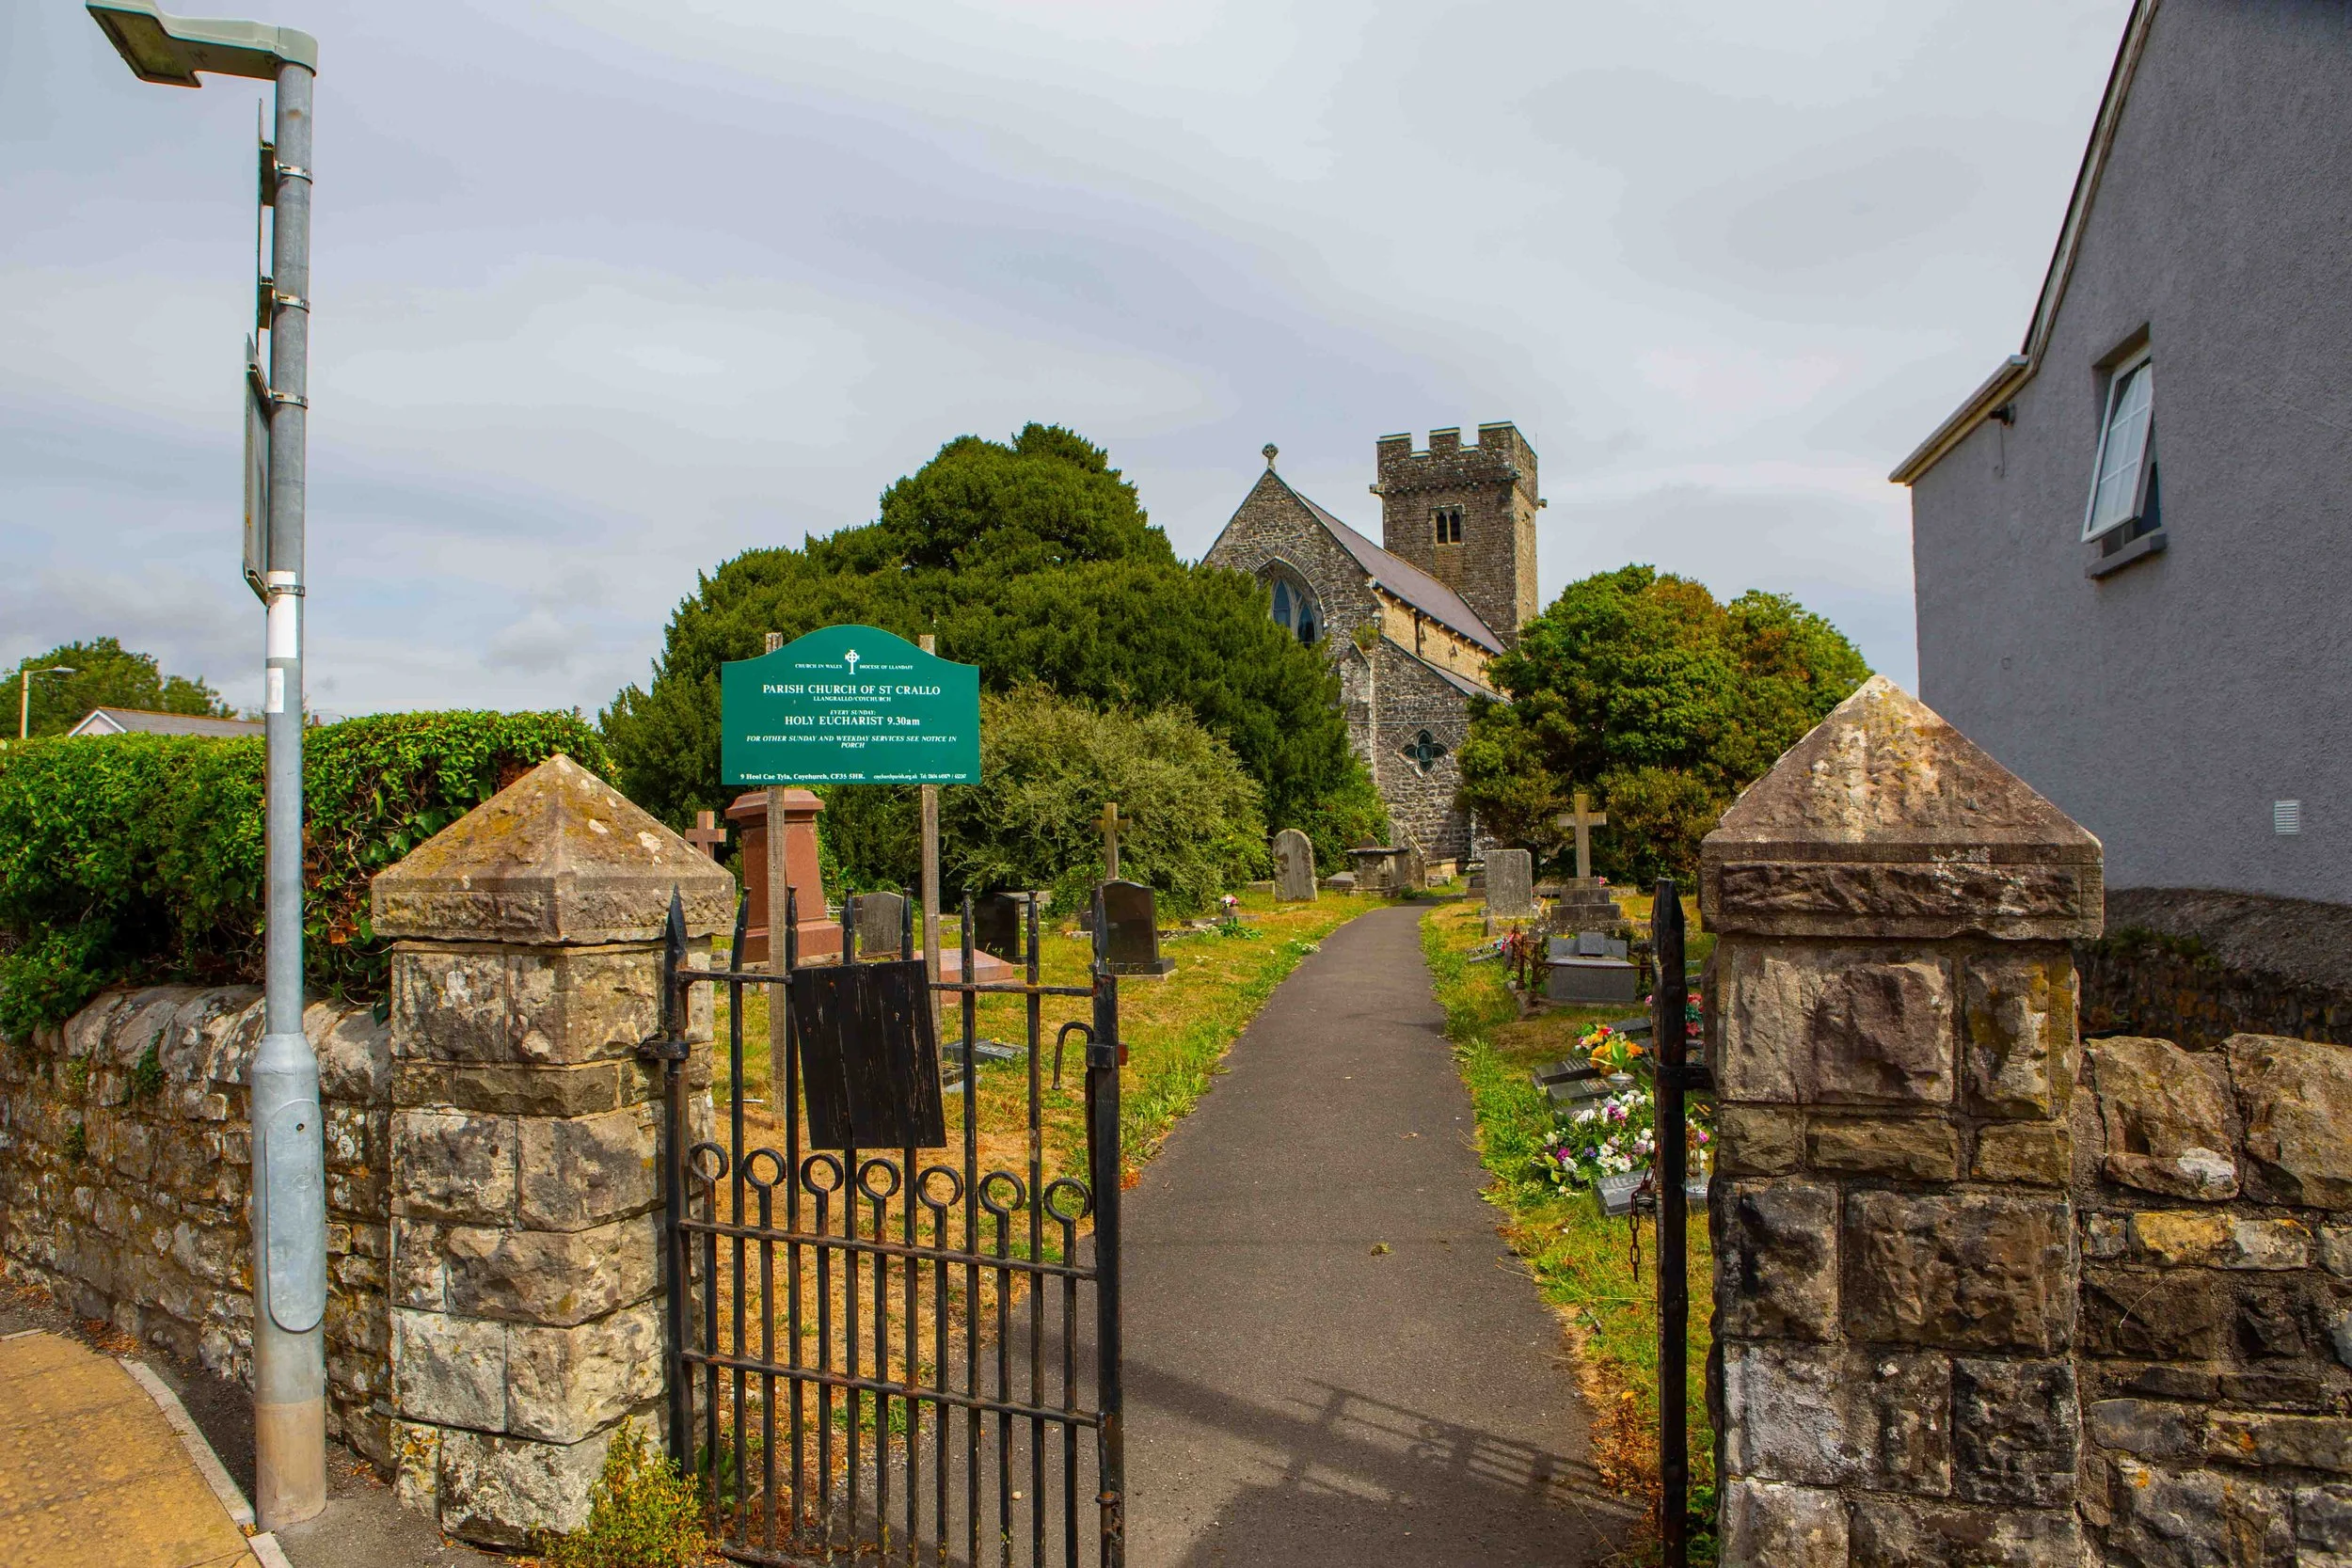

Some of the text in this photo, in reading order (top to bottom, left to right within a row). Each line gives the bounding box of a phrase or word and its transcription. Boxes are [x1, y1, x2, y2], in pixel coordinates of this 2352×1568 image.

[763, 685, 940, 695] PARISH CHURCH OF ST CRALLO
[785, 716, 920, 725] HOLY EUCHARIST 9.30am
